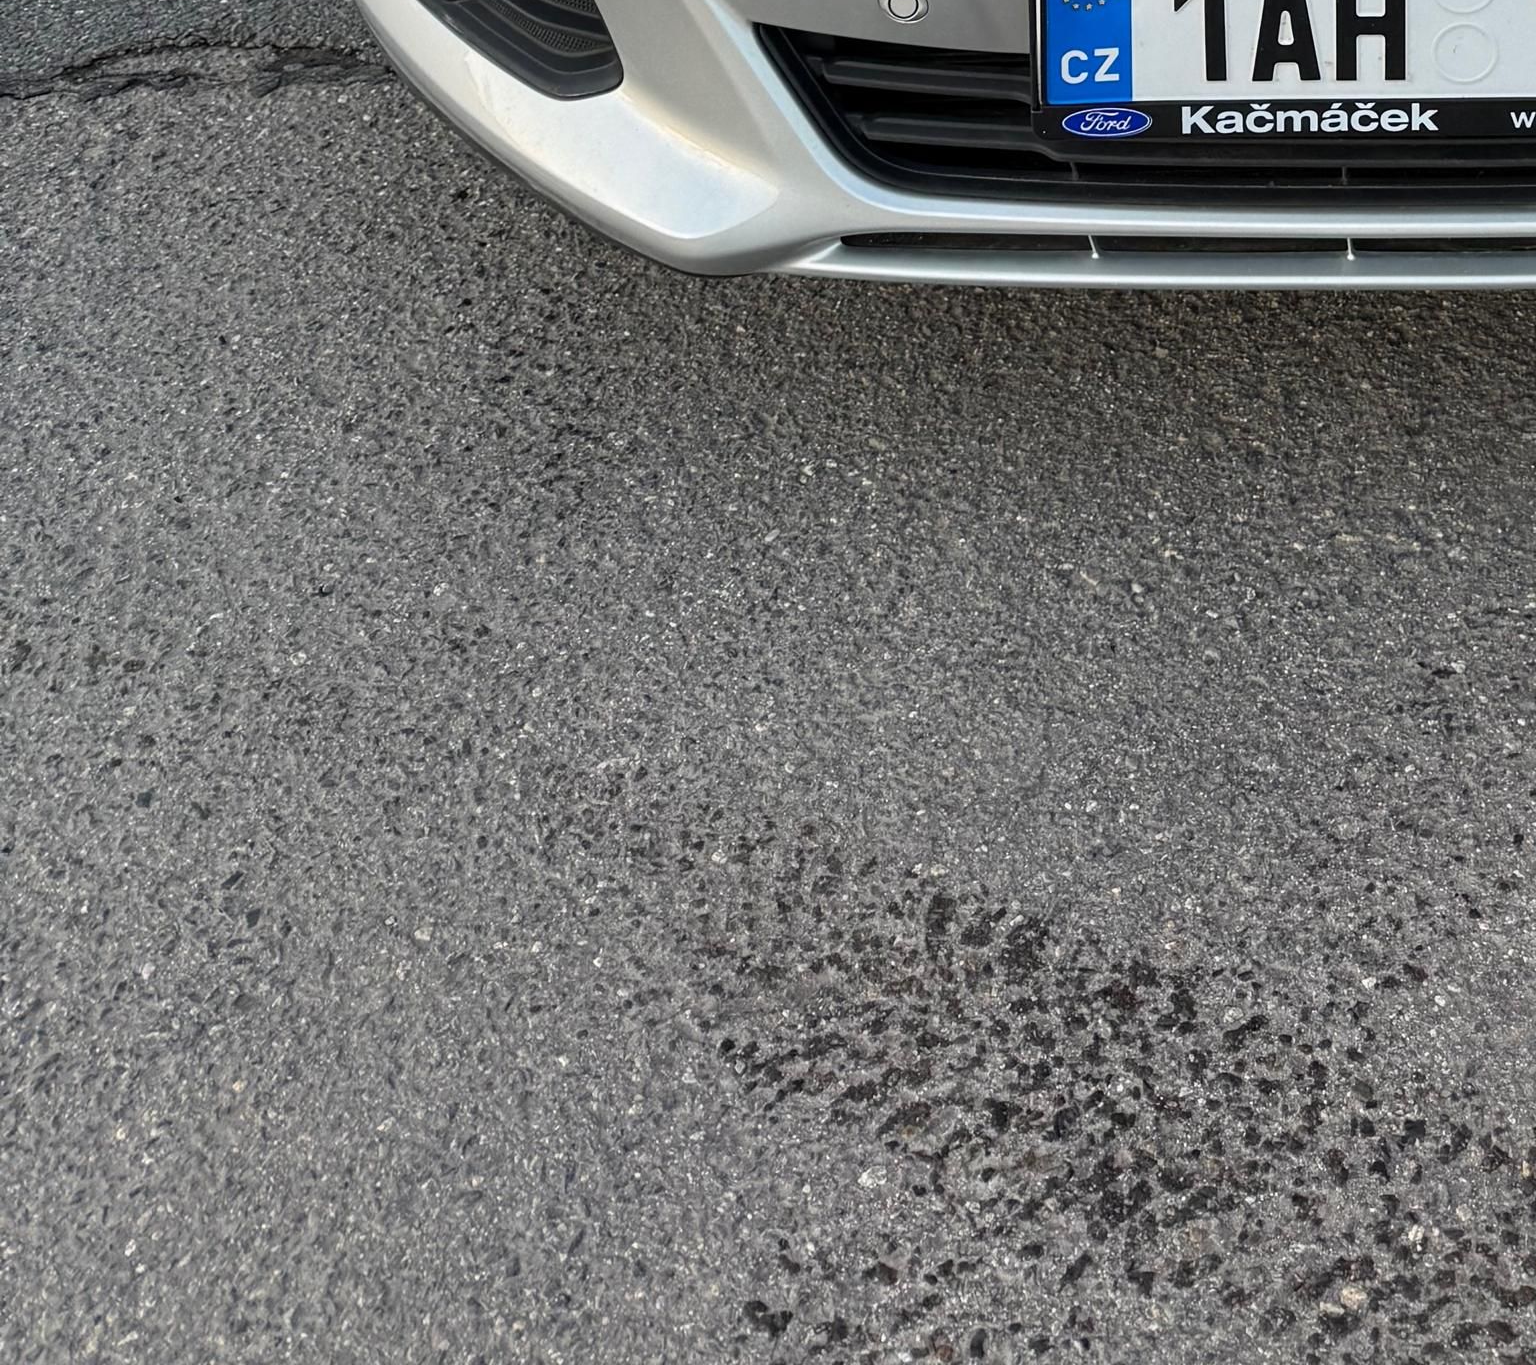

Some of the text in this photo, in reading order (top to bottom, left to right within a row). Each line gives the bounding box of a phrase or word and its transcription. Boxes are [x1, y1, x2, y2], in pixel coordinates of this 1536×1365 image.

[1060, 46, 1121, 85] CZ
[1080, 111, 1131, 132] Ford
[1181, 102, 1439, 135] Kačmáček
